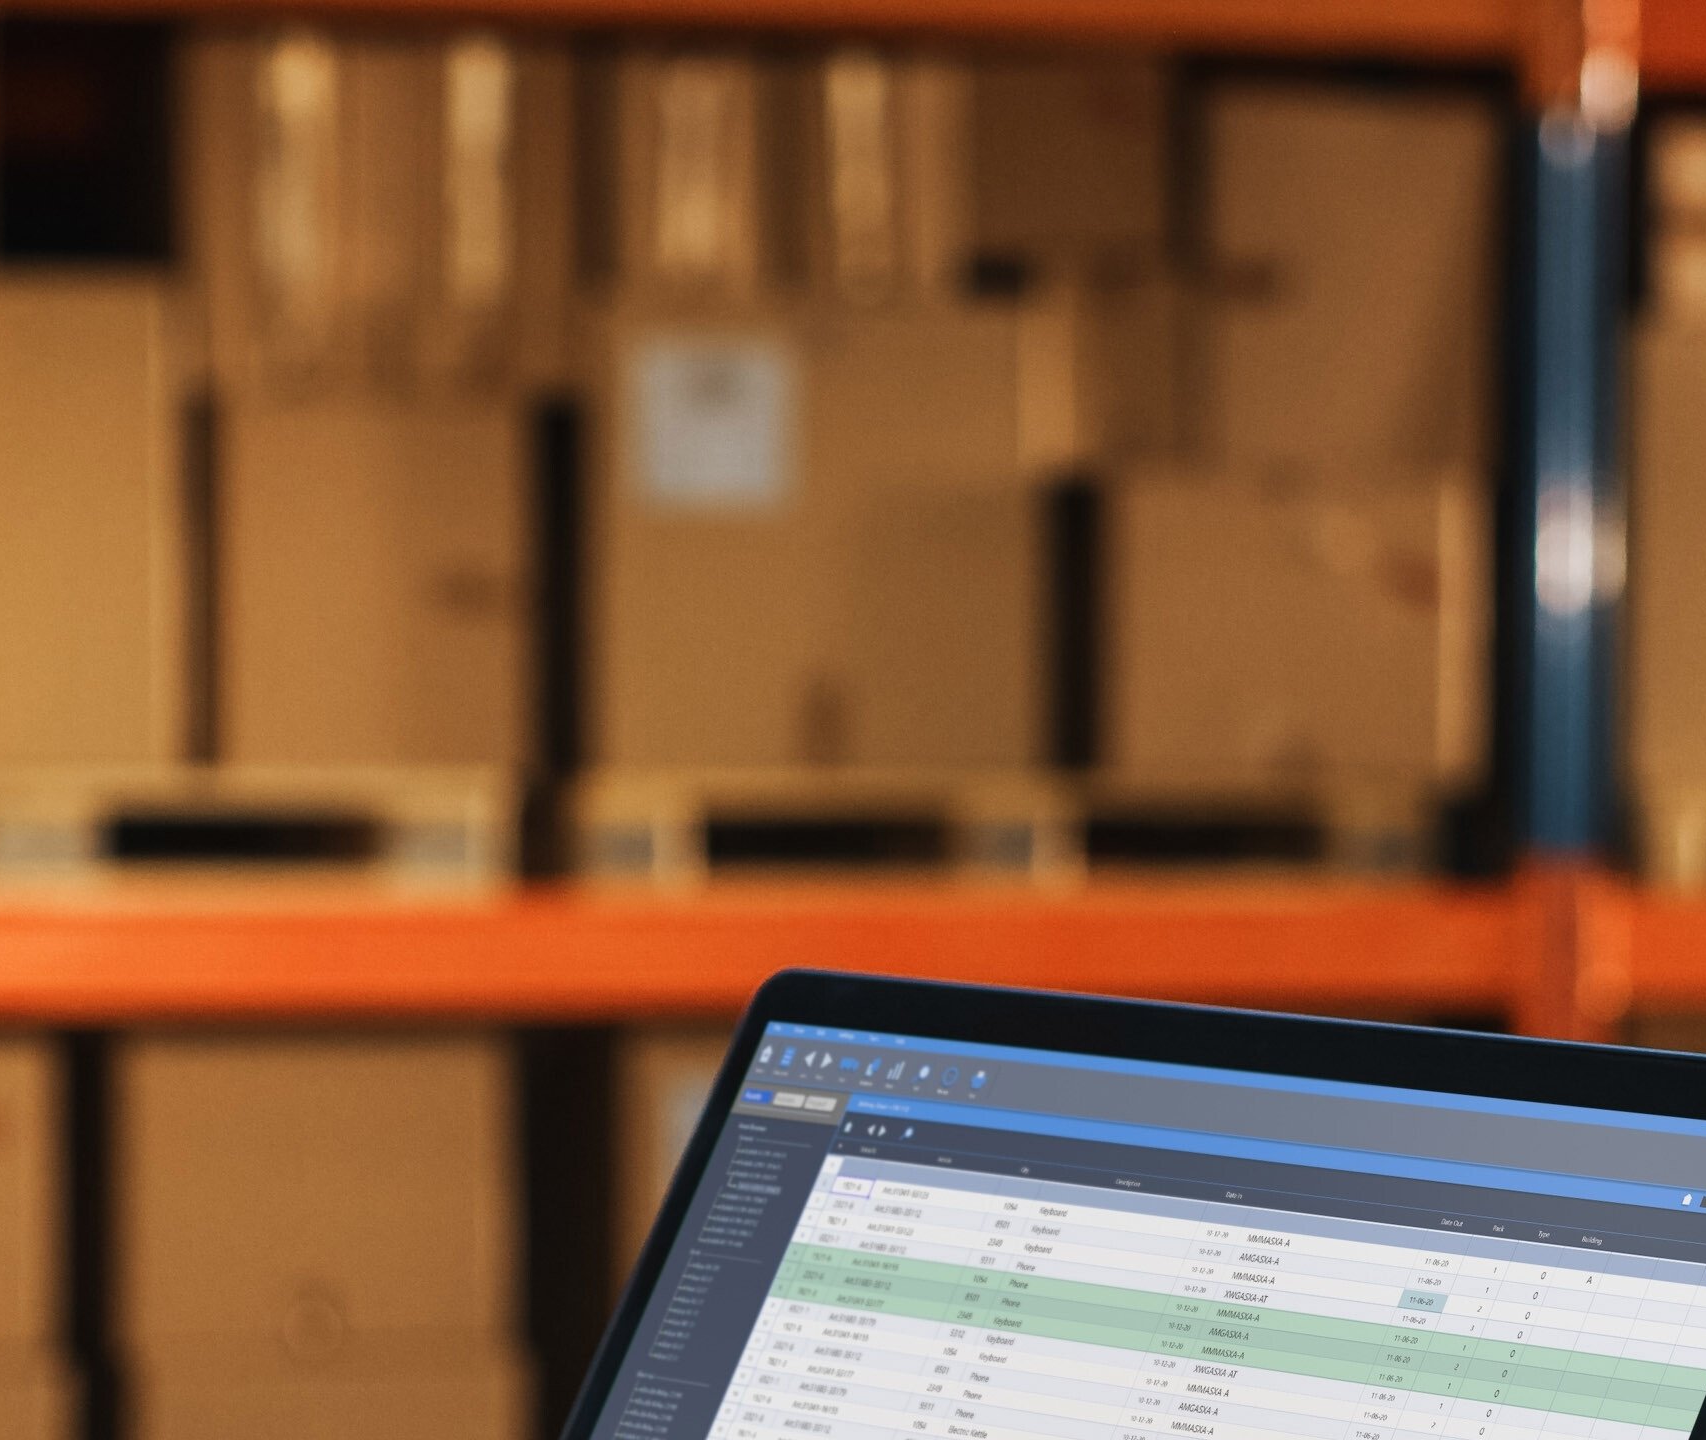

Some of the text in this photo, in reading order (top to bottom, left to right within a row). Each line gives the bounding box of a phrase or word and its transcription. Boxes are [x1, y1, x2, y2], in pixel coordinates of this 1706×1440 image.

[1225, 1191, 1237, 1199] Date
[1441, 1218, 1455, 1226] Date
[1581, 1236, 1602, 1246] Building
[1024, 1243, 1053, 1254] Keyboard
[1232, 1272, 1275, 1285] MMMASXA-A
[1031, 1225, 1060, 1236] Keyboard
[1239, 1253, 1280, 1265] AMGASXA-A
[1039, 1207, 1068, 1217] Keyboard
[1586, 1276, 1592, 1284] A
[1009, 1279, 1029, 1289] Phone
[1216, 1309, 1260, 1322] MMMASXA-A
[1016, 1261, 1036, 1272] Phone
[1224, 1290, 1269, 1303] XWGASXA-AT
[993, 1317, 1022, 1328] Keyboard
[1201, 1346, 1244, 1360] MMMASXA-A
[1001, 1298, 1021, 1308] Phone
[1208, 1328, 1249, 1340] AMGASXA-A
[979, 1353, 1007, 1364] Keyboard
[986, 1335, 1015, 1346] Keyboard
[955, 1408, 975, 1420] Phone
[962, 1389, 982, 1400] Phone
[1171, 1421, 1214, 1435] MMMASXA-A
[970, 1372, 990, 1383] Phone
[1178, 1402, 1218, 1416] AMGASXA-A
[948, 1425, 970, 1436] Electric
[970, 1429, 988, 1439] Kettle
